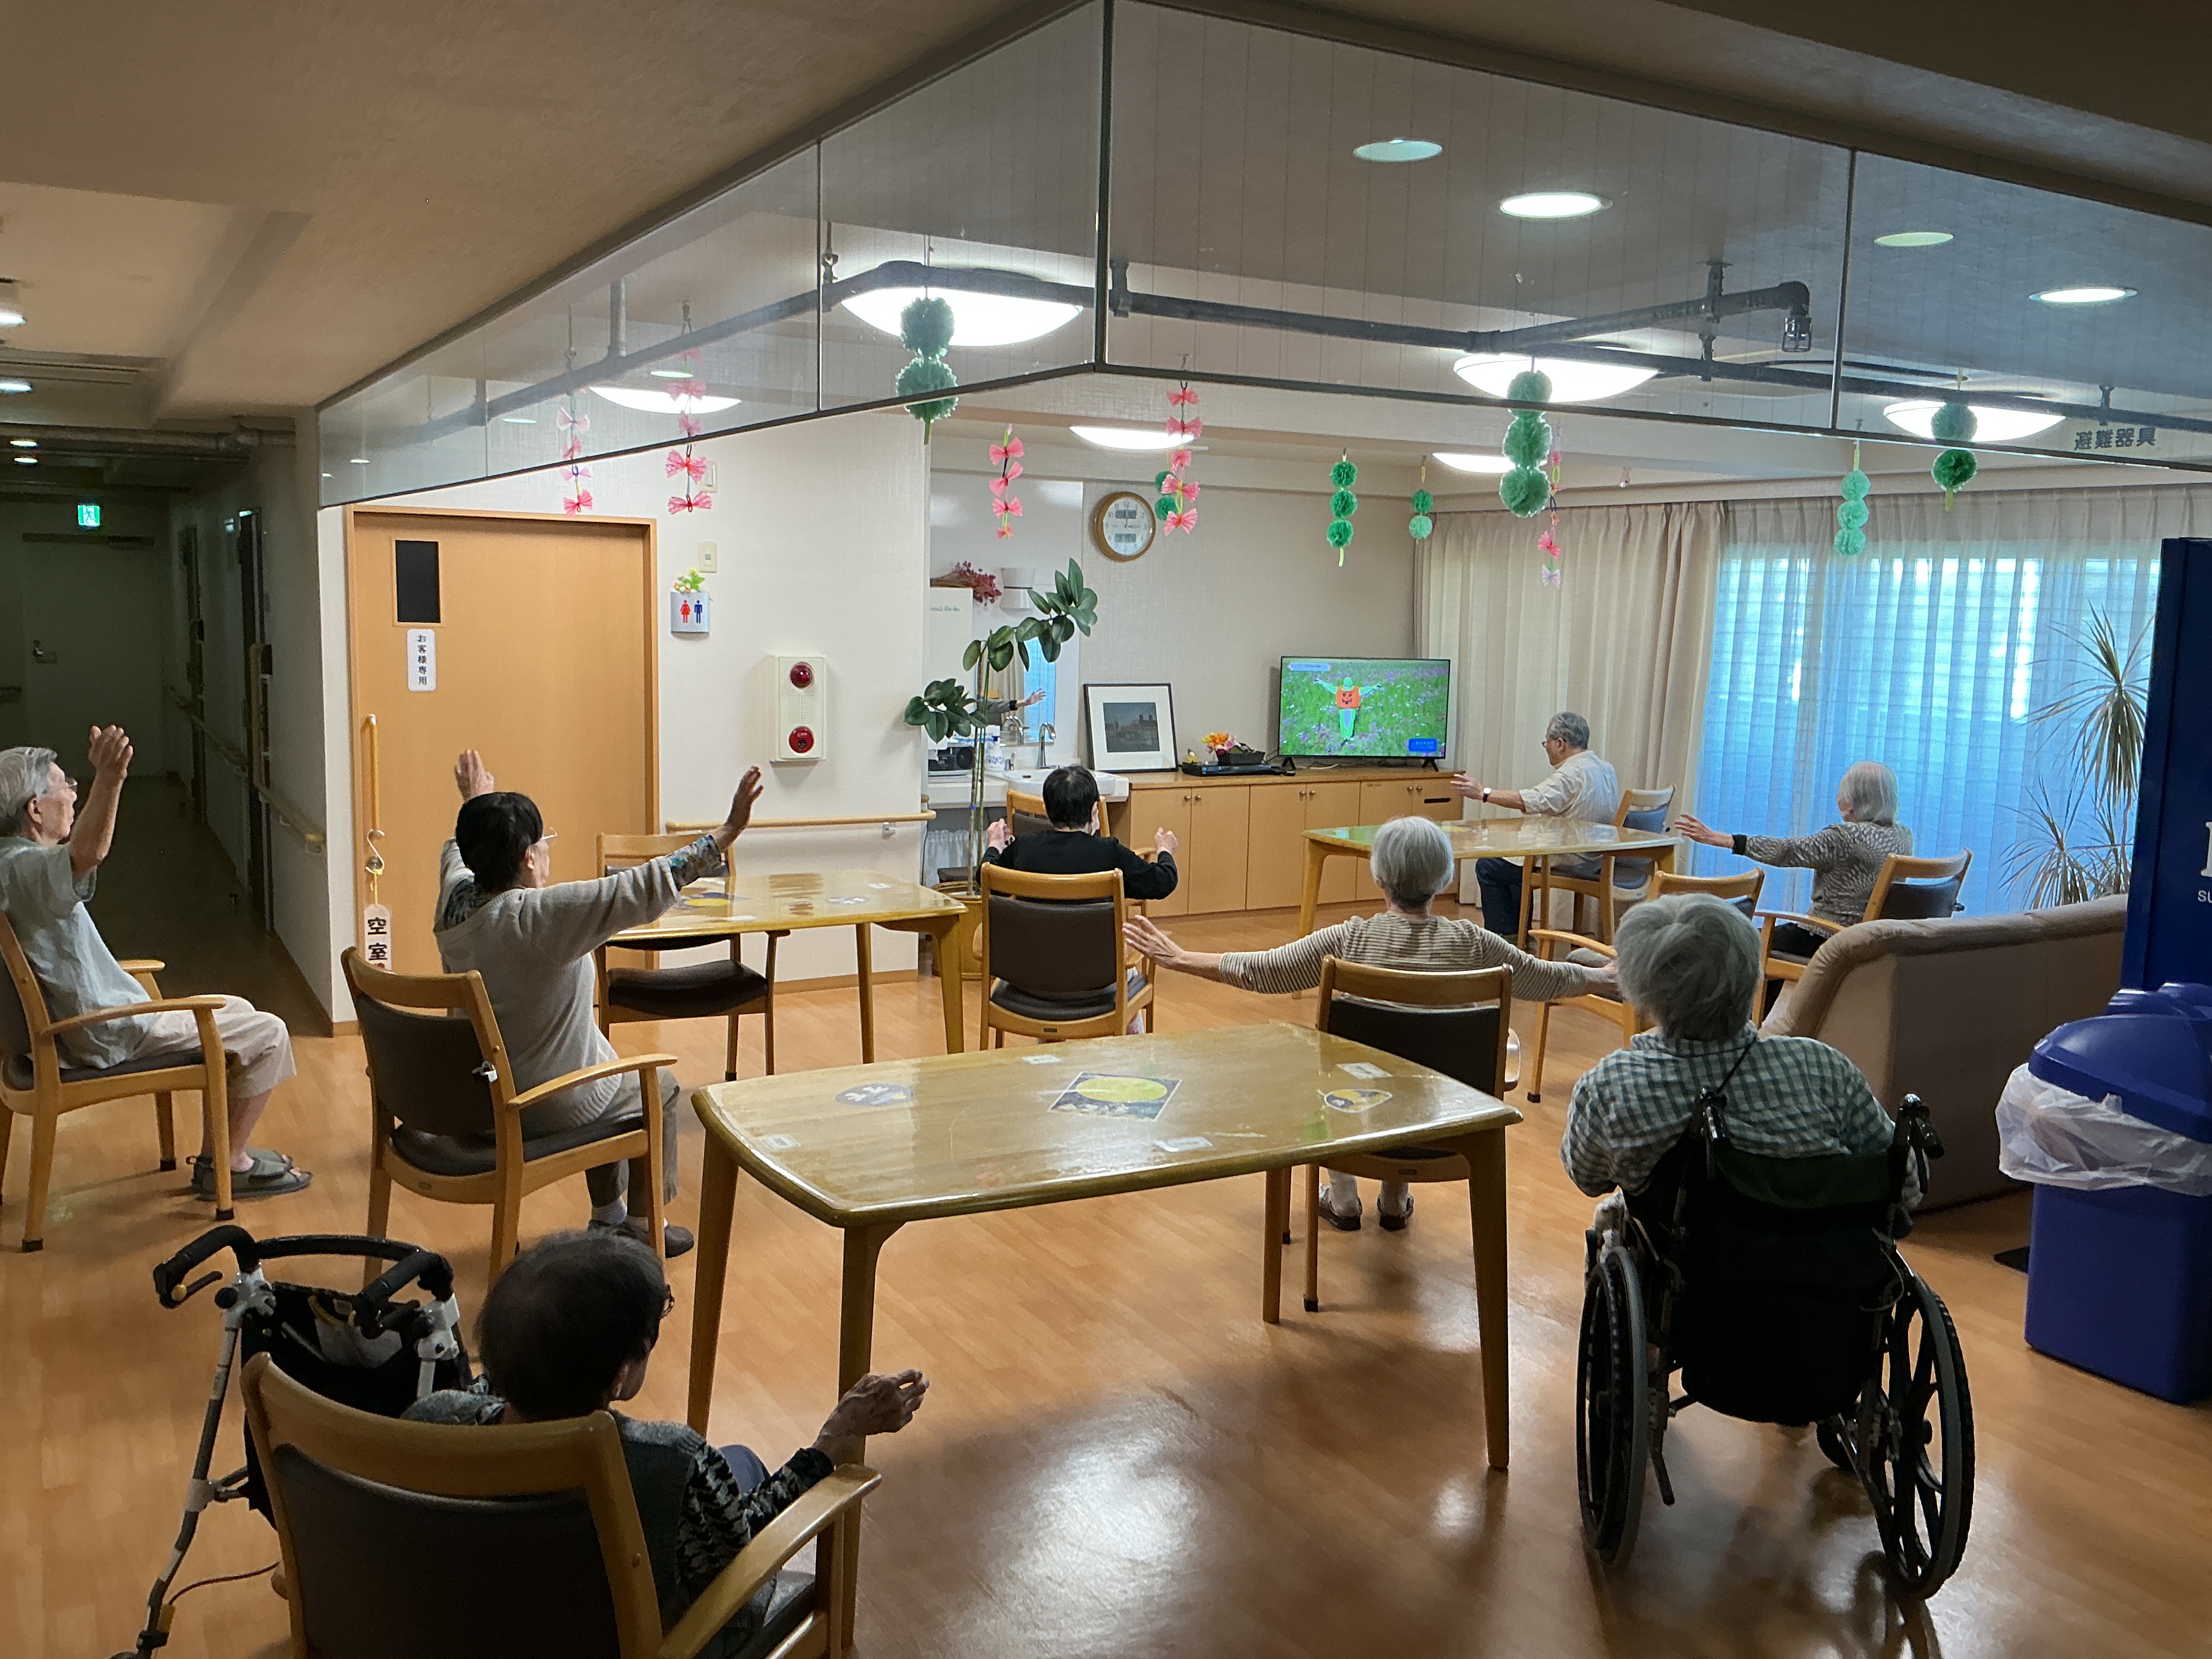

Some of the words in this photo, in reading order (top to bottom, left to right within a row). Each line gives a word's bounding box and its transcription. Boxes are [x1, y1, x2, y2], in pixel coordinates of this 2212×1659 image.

[2074, 427, 2156, 450] 避難器具
[417, 634, 427, 685] お客様専用
[368, 917, 387, 961] 空室
